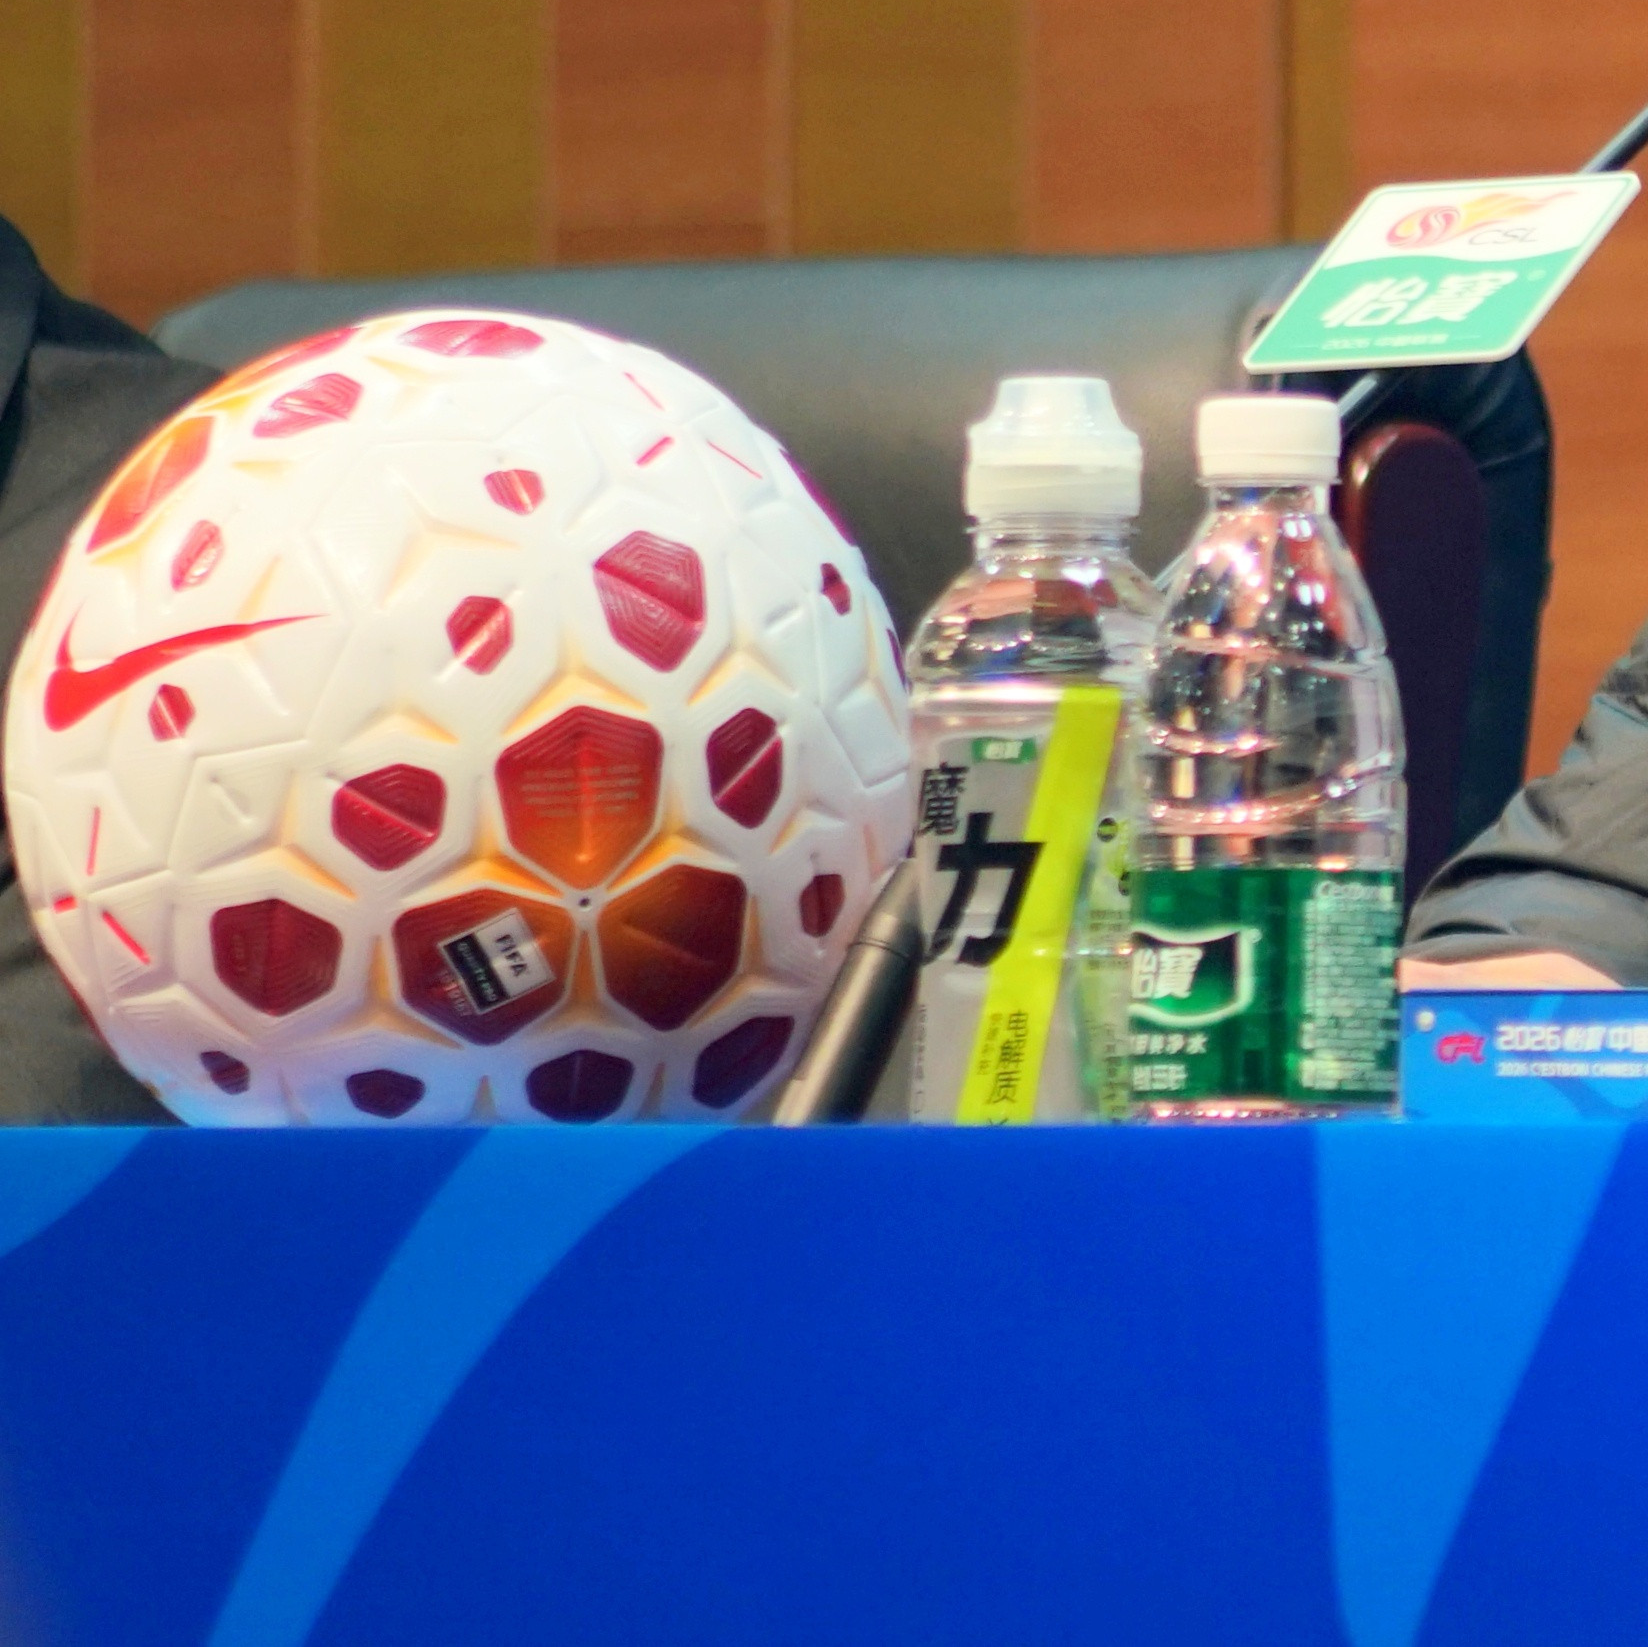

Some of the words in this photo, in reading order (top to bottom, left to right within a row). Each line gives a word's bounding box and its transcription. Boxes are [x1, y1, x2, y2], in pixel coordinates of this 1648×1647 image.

[1467, 227, 1539, 246] CSL
[1319, 268, 1519, 329] 怡寶
[495, 933, 528, 977] FIFA
